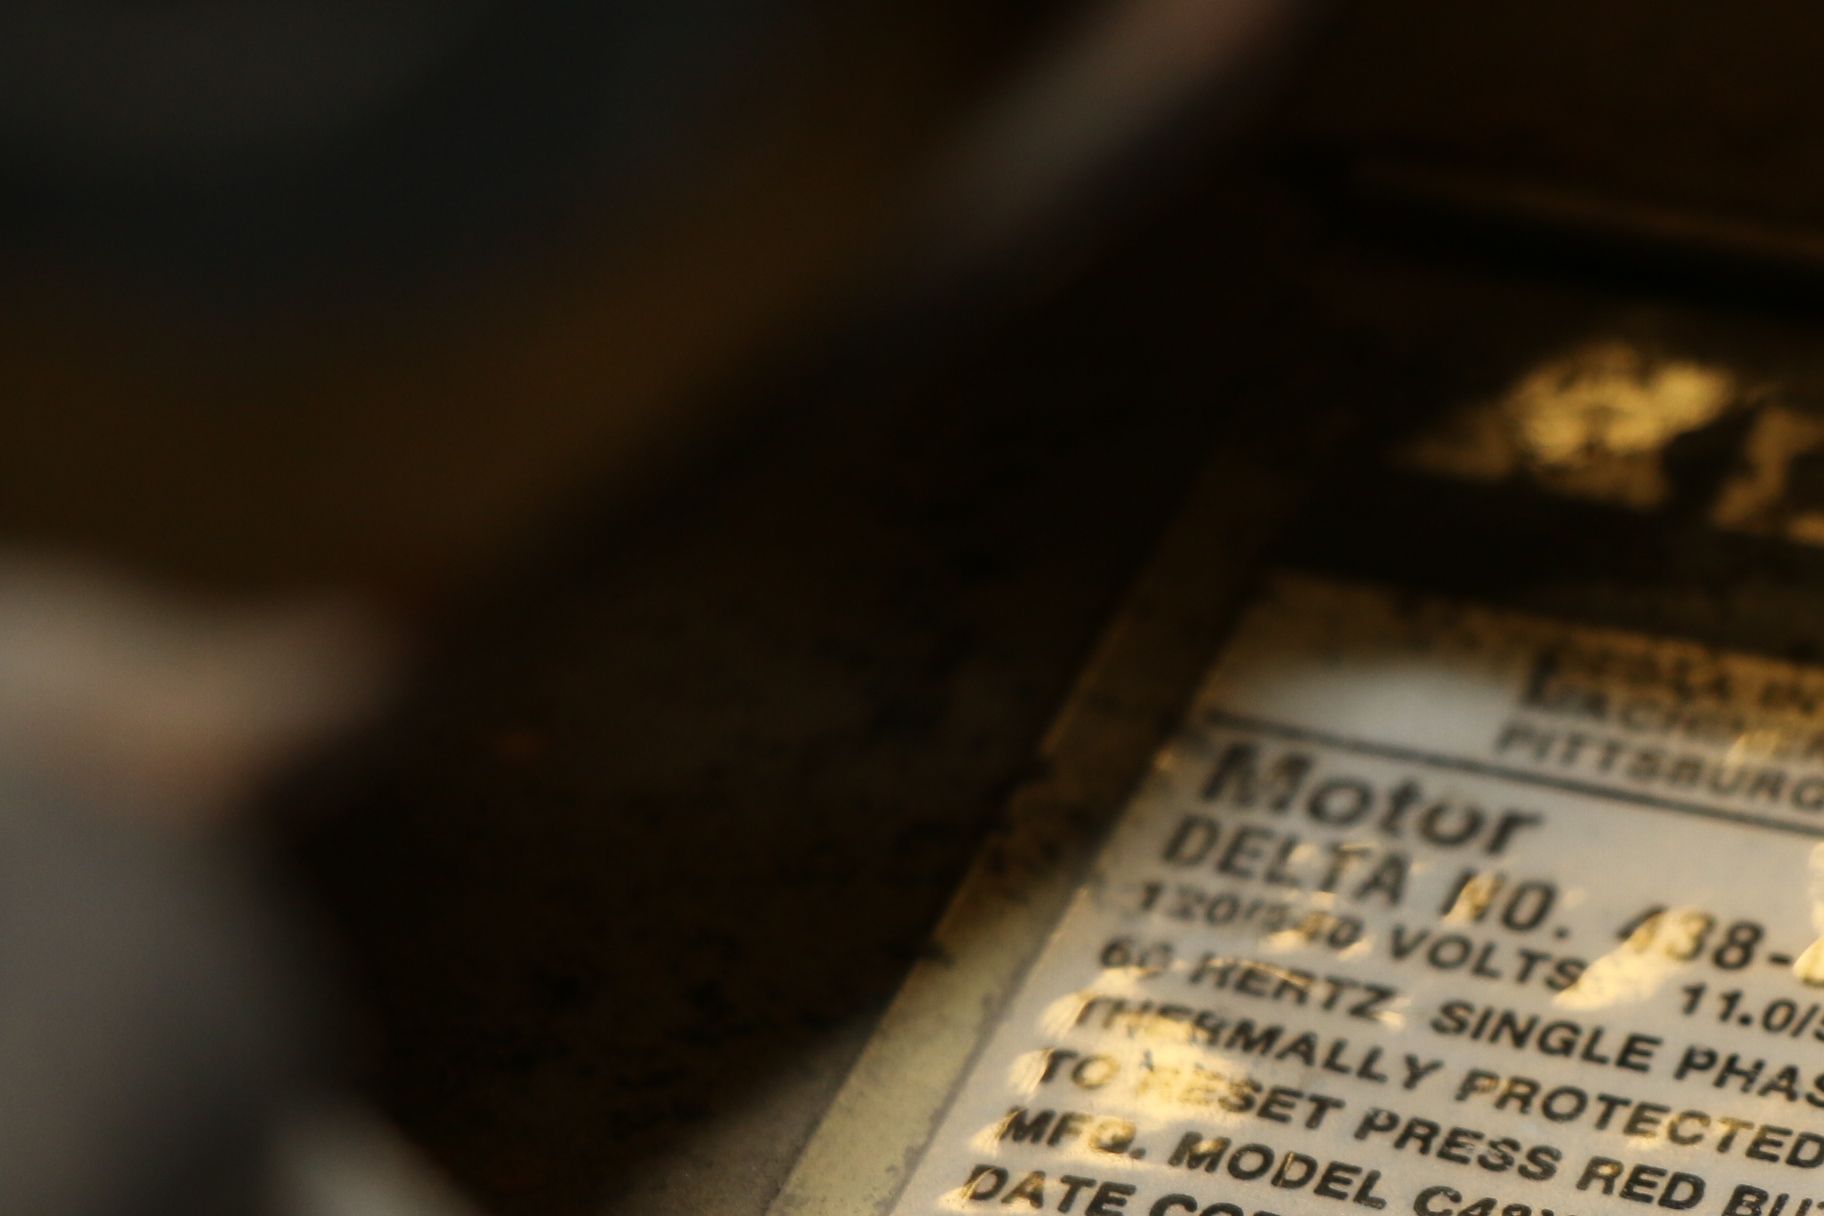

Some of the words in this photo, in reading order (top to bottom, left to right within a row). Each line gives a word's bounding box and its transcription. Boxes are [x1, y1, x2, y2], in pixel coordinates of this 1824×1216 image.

[1200, 740, 1545, 856] Motor
[1161, 814, 1415, 908] DELTA
[1440, 865, 1571, 940] NO.
[1099, 935, 1175, 978] 60
[1187, 953, 1408, 1025] HERTZ
[1430, 1000, 1664, 1074] SINGLE
[1387, 923, 1590, 992] VOLTS
[1075, 994, 1444, 1092] THERMALLY
[1040, 1046, 1120, 1090] TO
[1353, 1106, 1564, 1182] PRESS
[1575, 1156, 1707, 1211] RED
[1167, 1129, 1389, 1211] MODEL
